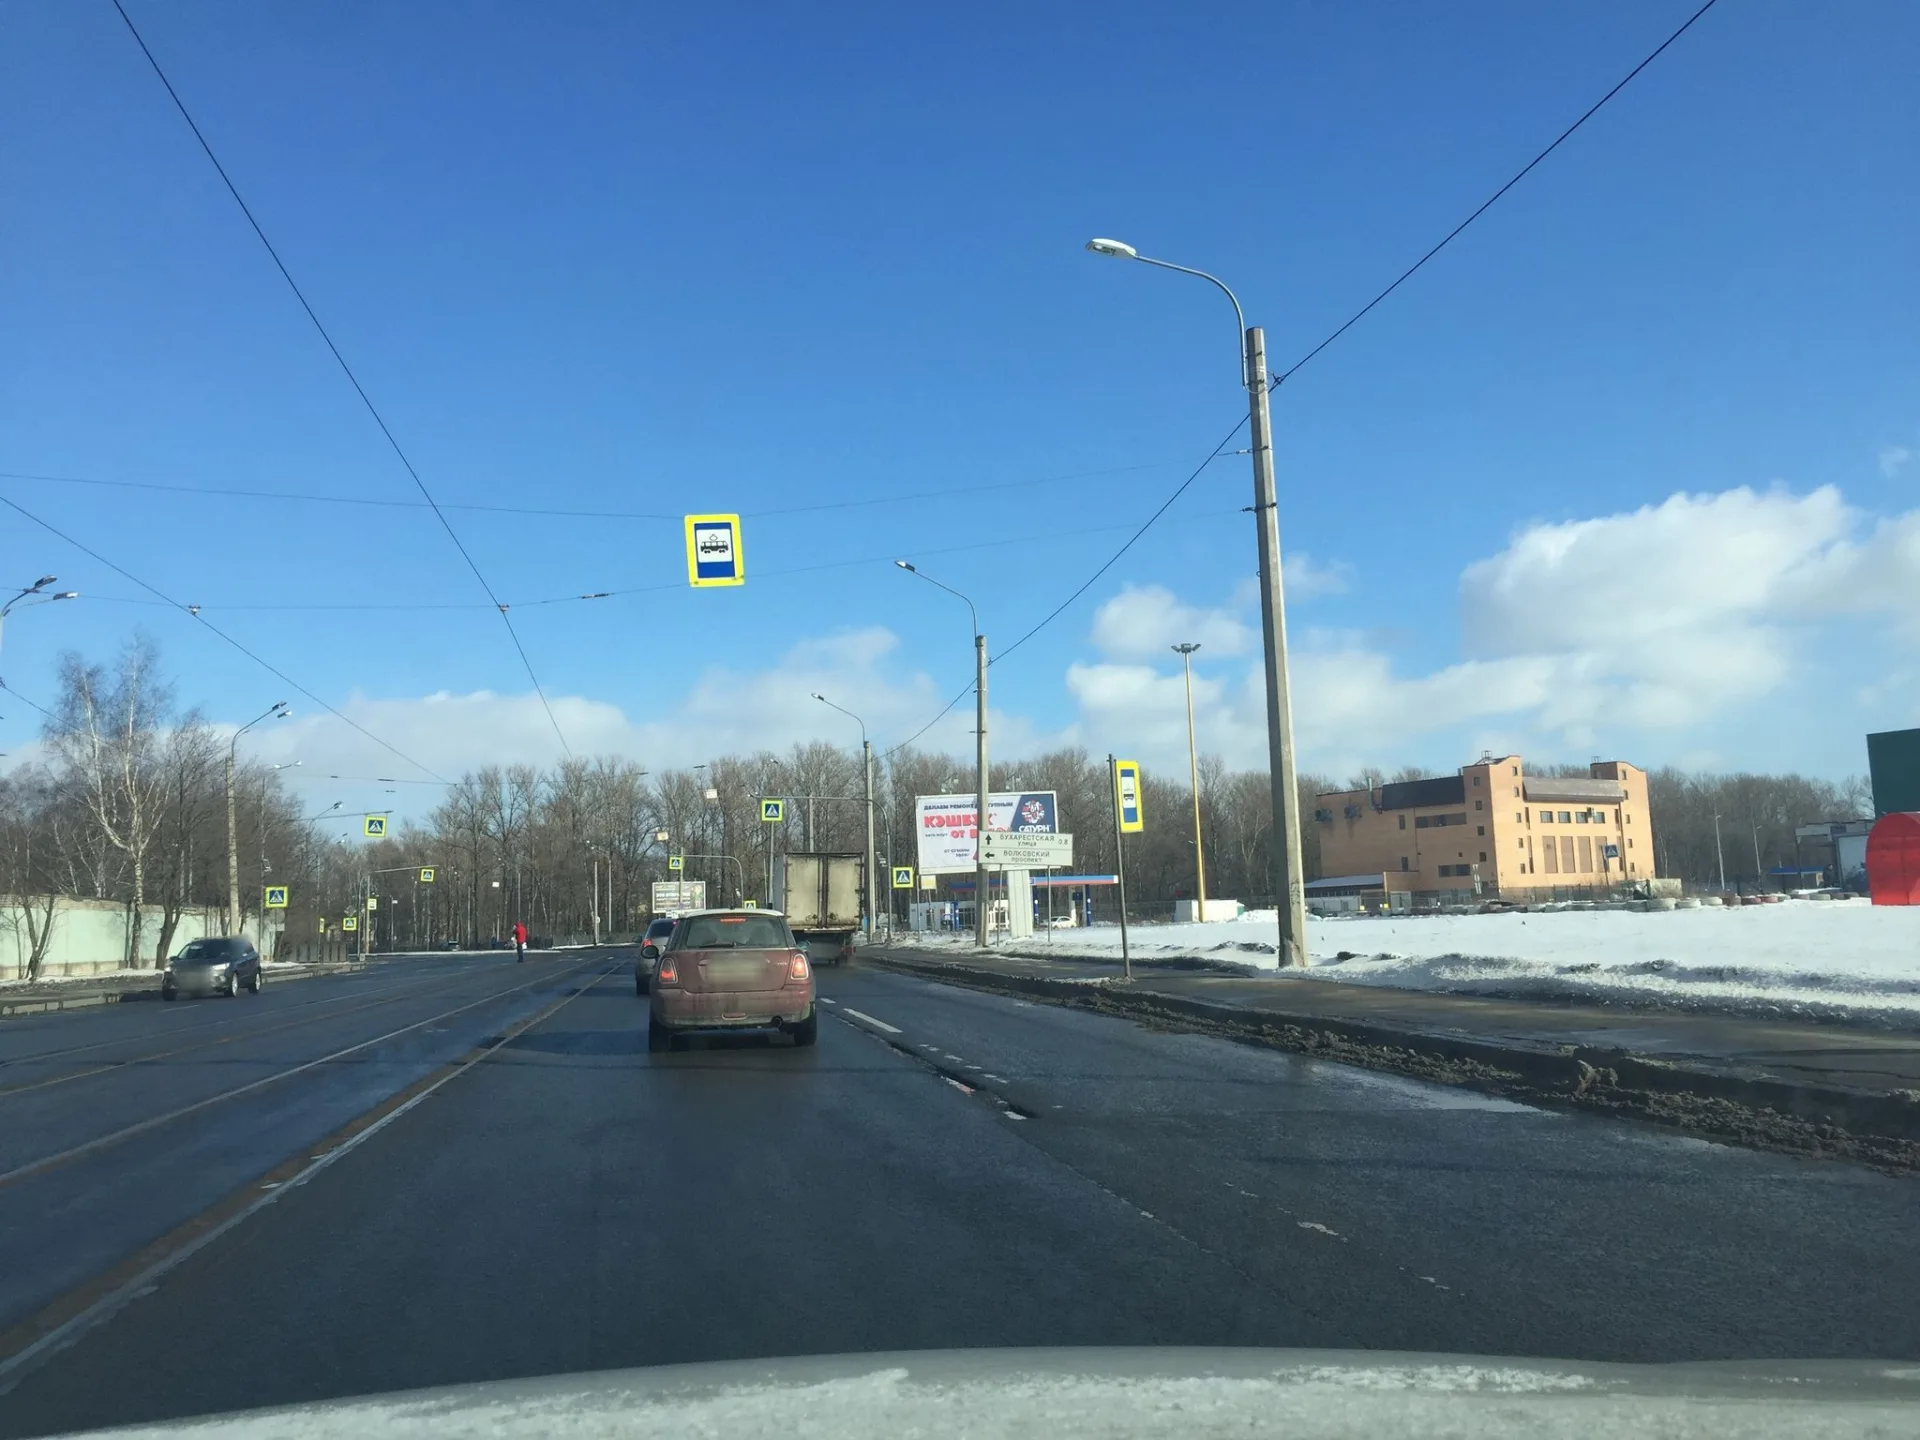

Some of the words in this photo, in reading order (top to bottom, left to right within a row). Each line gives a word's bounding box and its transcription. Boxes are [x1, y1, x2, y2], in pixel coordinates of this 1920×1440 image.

[924, 813, 994, 828] КЭШБ
[1018, 824, 1051, 833] САТУРН
[951, 830, 965, 839] ОТ
[1000, 834, 1054, 842] БУХАРЕСТСКАЯ
